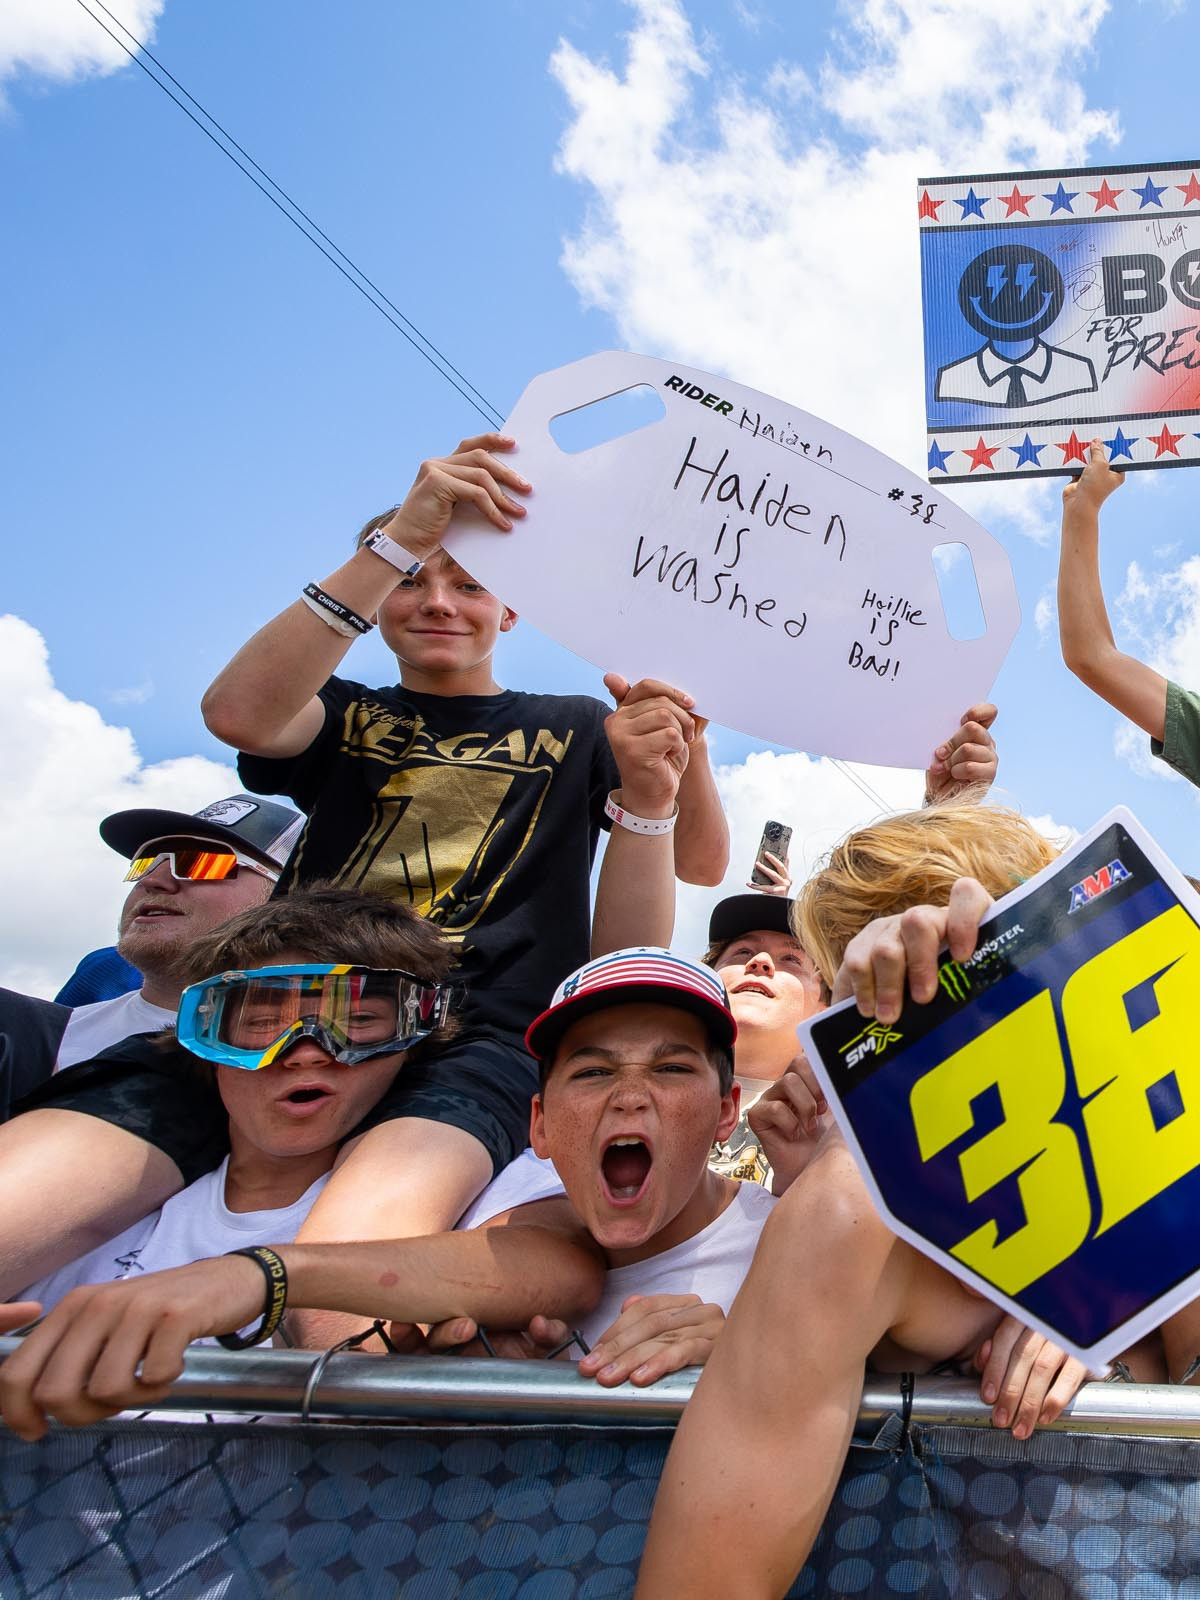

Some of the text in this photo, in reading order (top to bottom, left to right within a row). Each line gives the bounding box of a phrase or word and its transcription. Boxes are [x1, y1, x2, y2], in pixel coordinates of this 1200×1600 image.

[1087, 315, 1143, 343] FOR
[663, 375, 734, 417] RIDER
[673, 436, 848, 562] Haiden
[713, 514, 751, 569] is
[317, 594, 347, 615] CHRIST
[870, 611, 900, 646] is
[848, 640, 900, 682] Bad!
[1067, 859, 1133, 914] AMA
